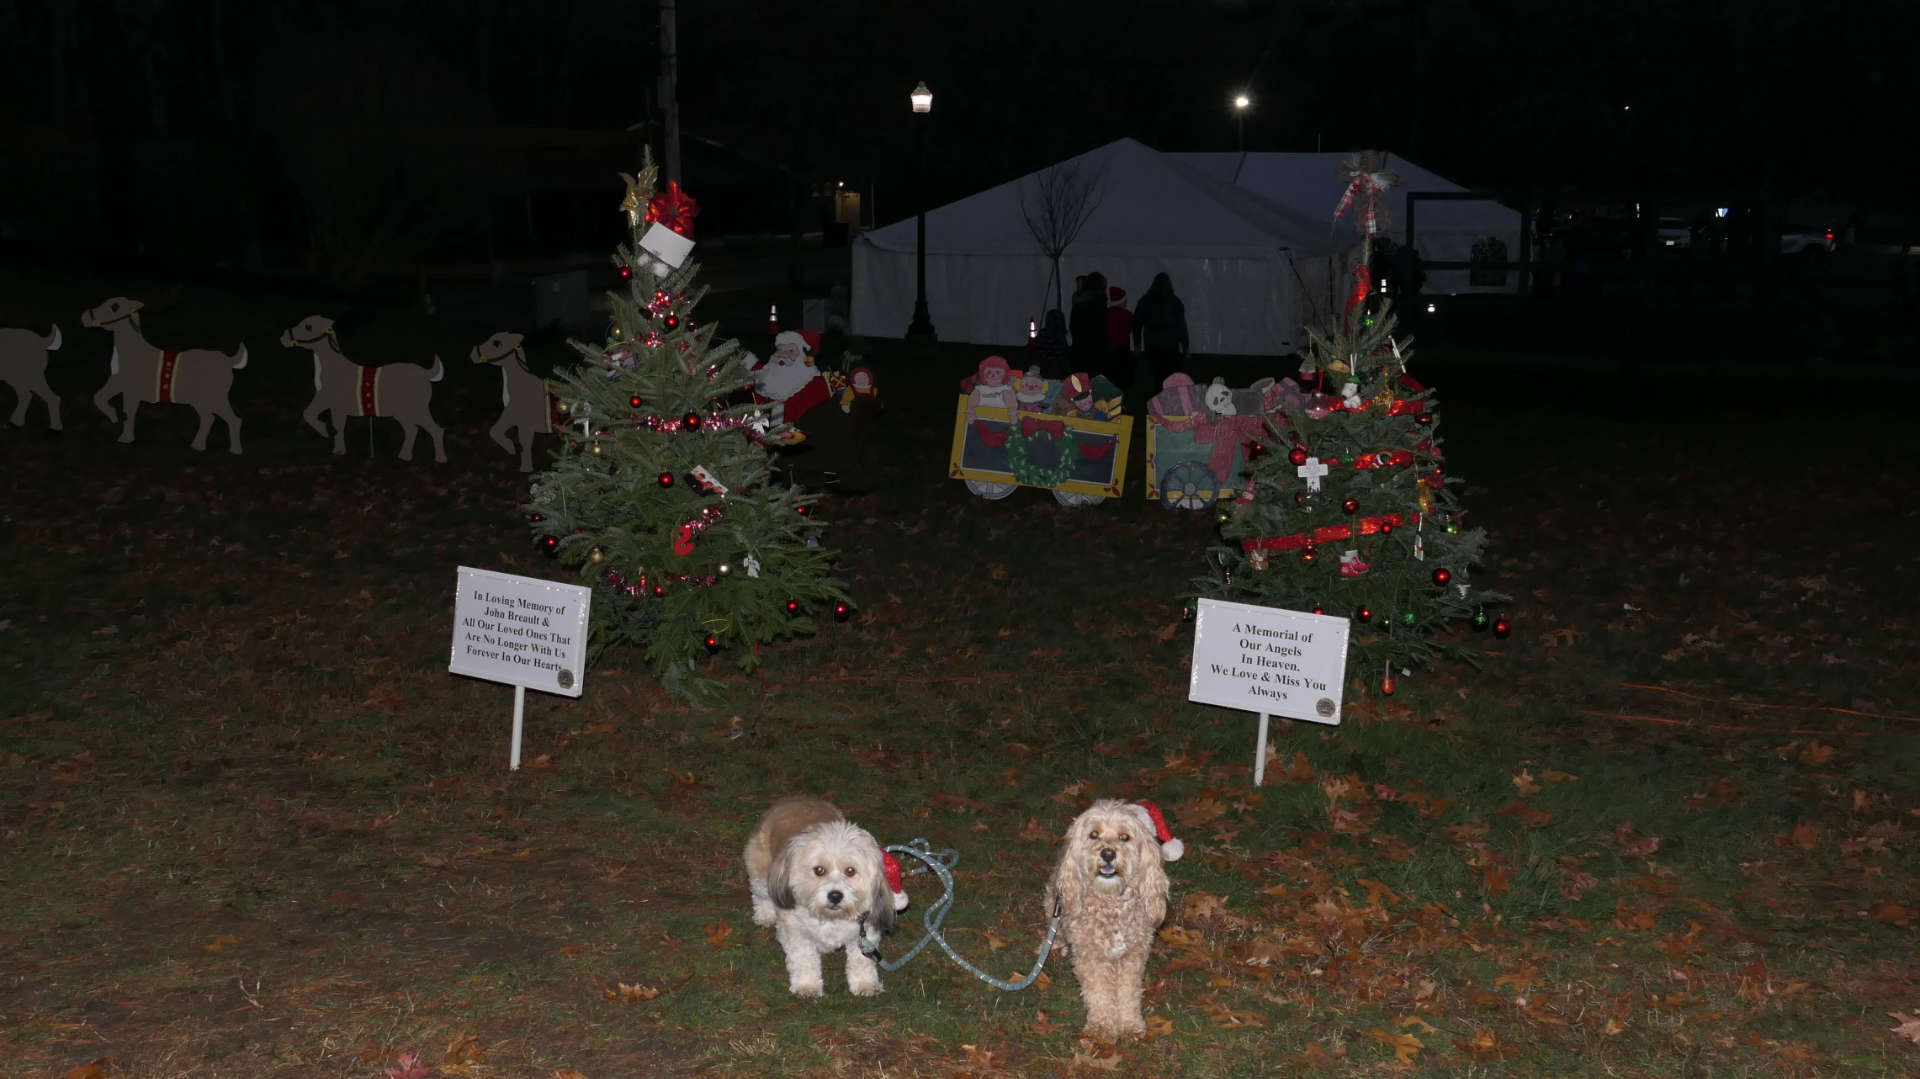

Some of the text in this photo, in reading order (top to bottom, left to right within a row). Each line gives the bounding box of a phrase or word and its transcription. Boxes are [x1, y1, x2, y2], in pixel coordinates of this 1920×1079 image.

[474, 591, 565, 615] In Loving Memory of
[484, 607, 549, 627] John Breault &
[464, 618, 570, 645] All Our Loved Ones That
[1232, 624, 1313, 643] A Memorial of
[466, 632, 565, 658] Are No Longer With Us
[1240, 639, 1302, 656] Our Angels
[467, 645, 499, 660] Forever
[502, 652, 511, 661] In
[514, 655, 531, 666] Our
[1242, 654, 1300, 672] In Heaven.
[1211, 664, 1326, 690] We Love & Miss You
[1248, 686, 1287, 701] Always
